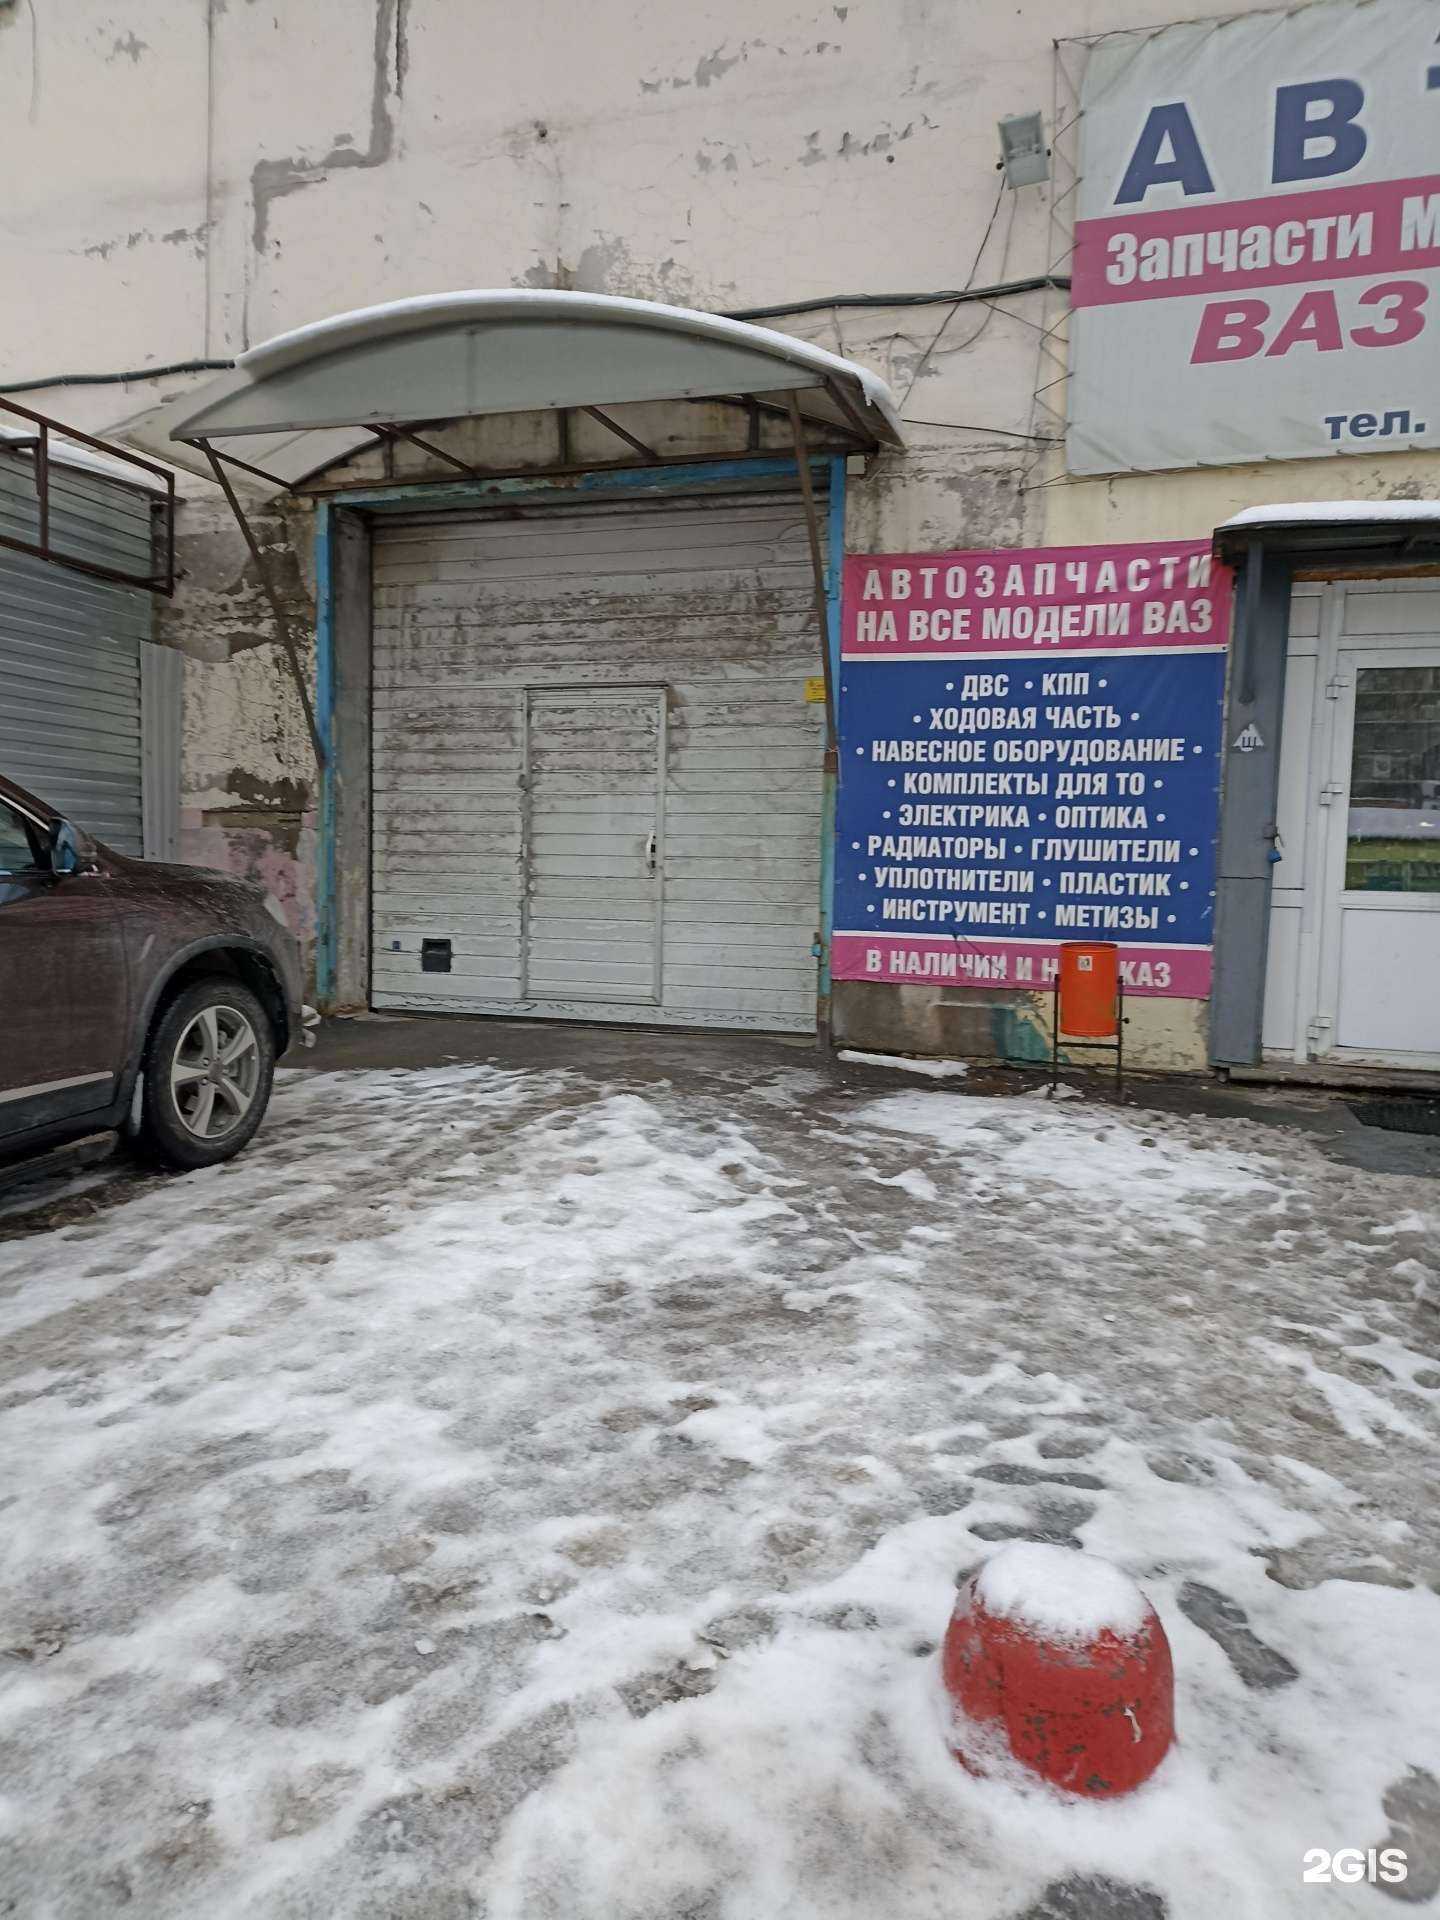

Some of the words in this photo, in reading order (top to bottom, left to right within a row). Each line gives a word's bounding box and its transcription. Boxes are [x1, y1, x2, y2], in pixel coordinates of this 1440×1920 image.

[1113, 66, 1440, 205] АВ
[1106, 211, 1374, 287] Запчасти
[1190, 280, 1430, 366] ВАЗ
[1324, 410, 1426, 441] тел.
[862, 554, 1212, 601] АВТОЗАПЧАСТИ
[856, 610, 898, 642] НА
[908, 608, 971, 641] ВСЕ
[982, 602, 1130, 645] МОДЕЛИ
[1142, 598, 1213, 635] ВАЗ
[961, 673, 1010, 701] ДВС
[1041, 672, 1090, 696] КПП
[929, 707, 1036, 734] ХОДОВАЯ
[1045, 705, 1122, 730] ЧАСТЬ
[871, 740, 986, 763] НАВЕСНОЕ
[993, 738, 1186, 766] ОБОРУДОВАНИЕ
[903, 772, 1048, 796] КОМПЛЕКТЫ
[1055, 772, 1107, 800] ДЛЯ
[1115, 772, 1145, 796] ТО
[899, 804, 1030, 828] ЭЛЕКТРИКА
[1055, 805, 1148, 829] ОПТИКА
[868, 835, 1006, 861] РАДИАТОРЫ
[1031, 838, 1181, 863] ГЛУШИТЕЛИ
[874, 866, 1034, 893] УПЛОТНИТЕЛИ
[1059, 871, 1171, 896] ПЛАСТИК
[882, 898, 1030, 925] ИНСТРУМЕНТ
[1055, 904, 1159, 930] МЕТИЗЫ
[866, 949, 882, 973] В
[890, 950, 1007, 980] НАЛИЧИИ
[1016, 956, 1032, 981] И
